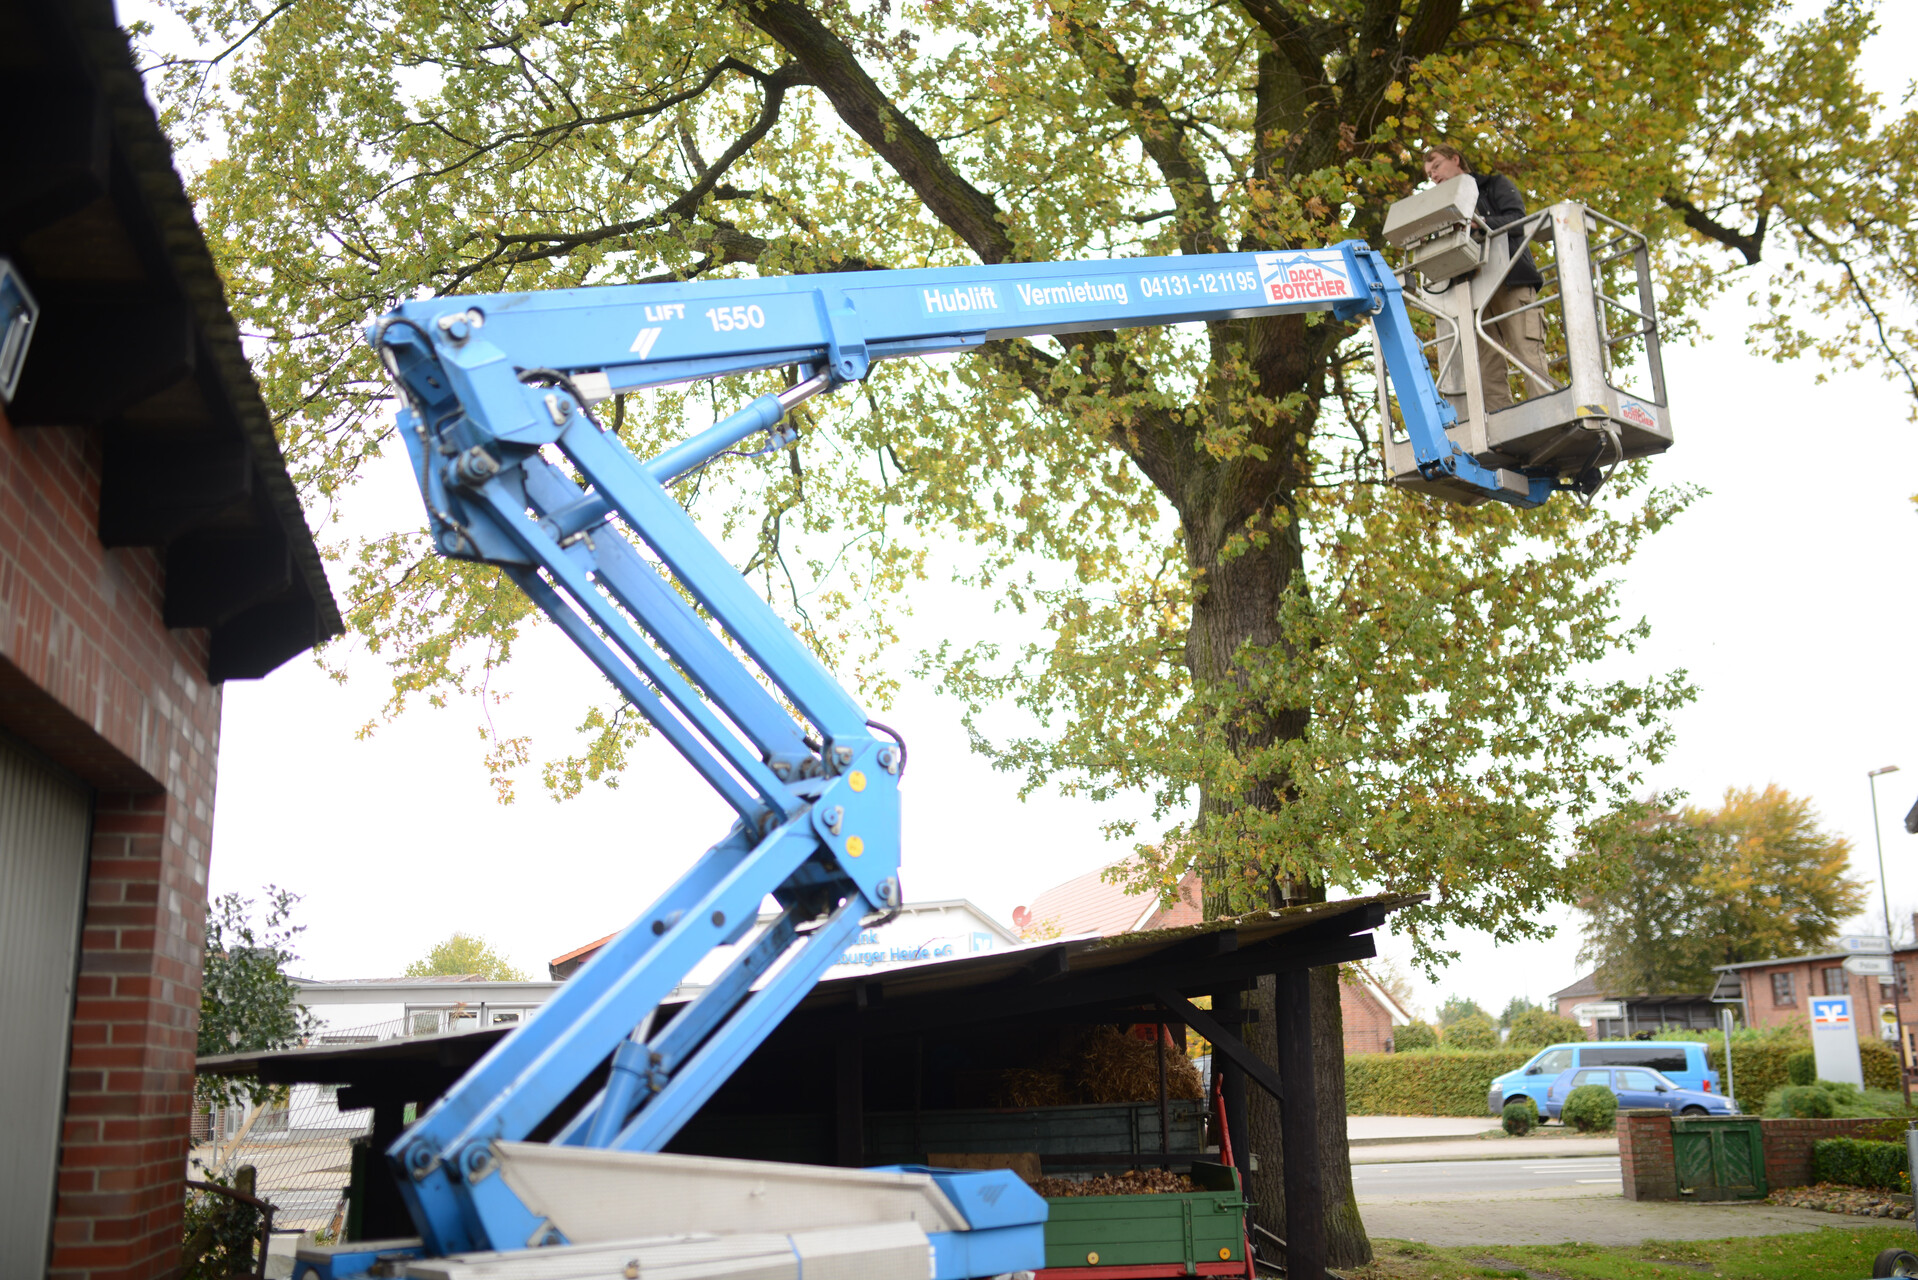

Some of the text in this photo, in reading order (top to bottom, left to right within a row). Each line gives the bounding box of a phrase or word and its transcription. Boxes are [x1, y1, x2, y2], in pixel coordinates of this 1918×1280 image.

[1288, 268, 1324, 283] DACH
[923, 286, 998, 313] Hublift
[1016, 281, 1129, 306] Vermietung
[644, 303, 685, 322] LIFT
[705, 304, 765, 332] 1550
[890, 944, 930, 961] Heide
[933, 943, 953, 958] eG
